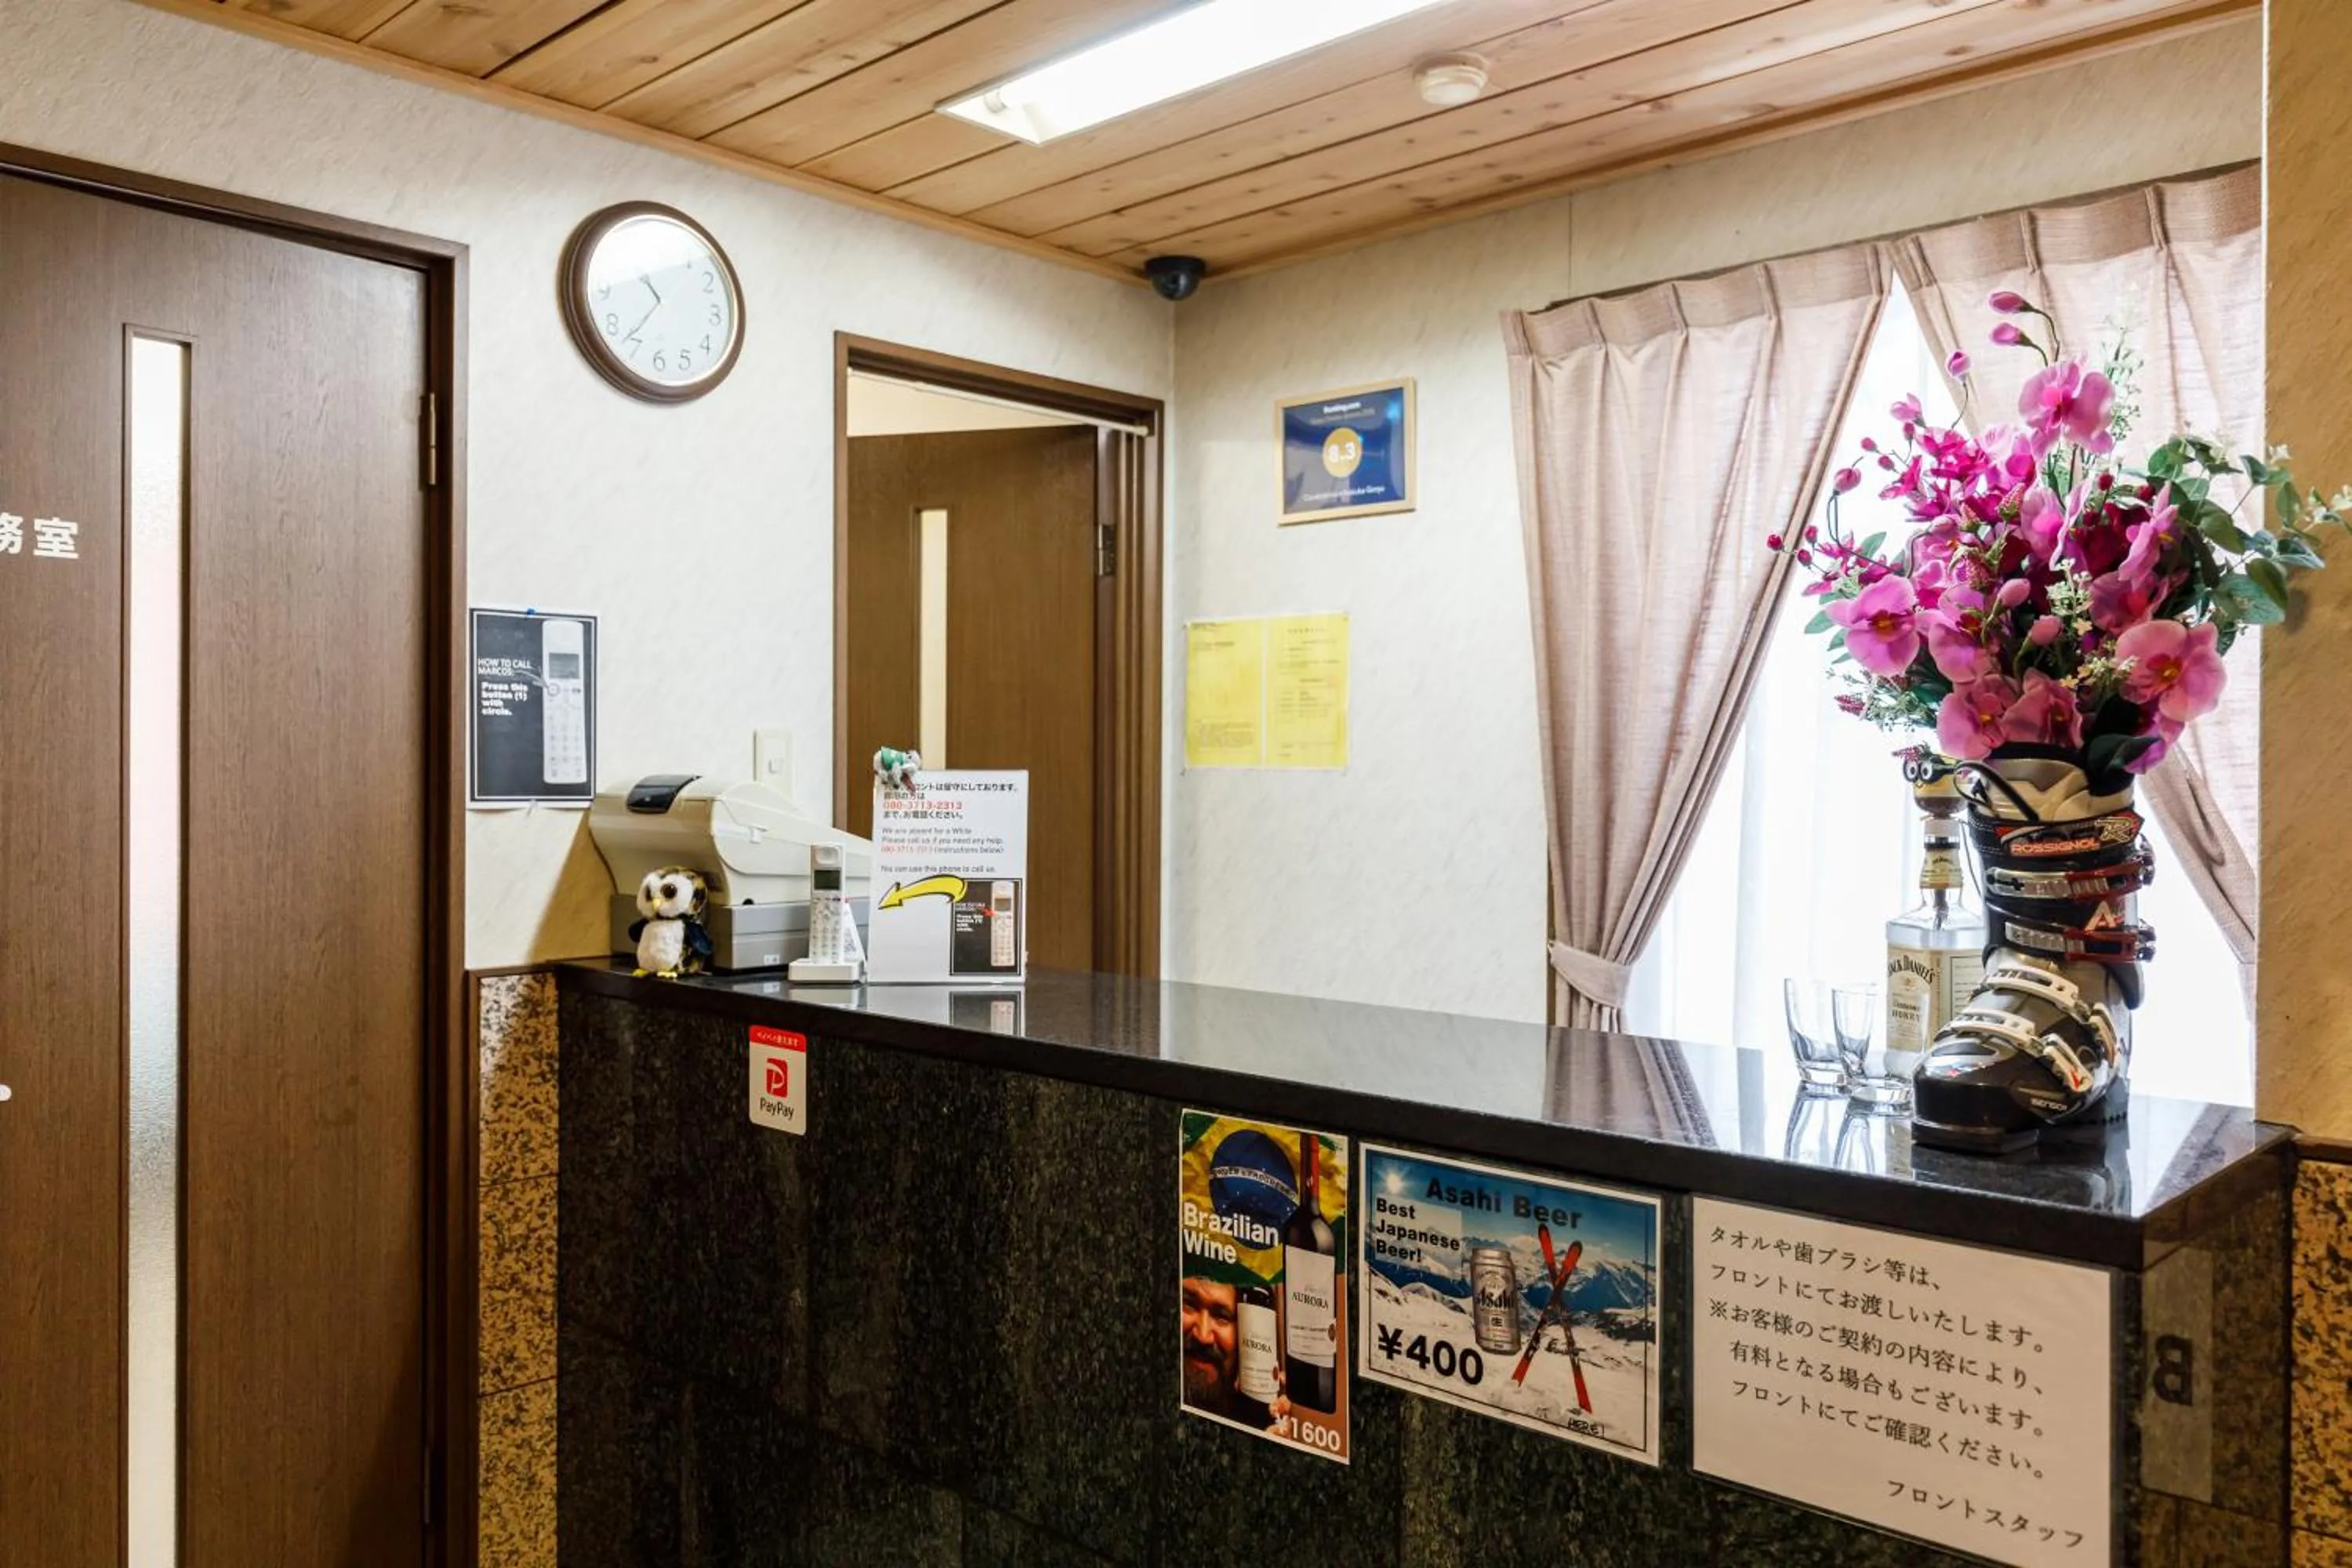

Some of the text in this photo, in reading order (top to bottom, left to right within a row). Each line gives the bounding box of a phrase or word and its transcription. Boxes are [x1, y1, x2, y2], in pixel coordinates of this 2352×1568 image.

[702, 271, 714, 293] 2
[606, 313, 619, 336] 8
[709, 304, 721, 326] 3
[699, 334, 711, 356] 4
[653, 350, 666, 371] 6
[679, 350, 691, 370] 5
[1329, 441, 1356, 463] 8.3
[500, 659, 511, 667] TO
[513, 659, 531, 669] CALL
[2011, 837, 2101, 855] ROSSIGNOL
[760, 1098, 794, 1120] PayPay
[1376, 1197, 1416, 1220] Best
[1426, 1178, 1583, 1229] Asahi Beer
[1183, 1202, 1279, 1247] Brazilian
[1376, 1219, 1460, 1251] Japanese
[1183, 1229, 1237, 1265] Wine
[1376, 1239, 1421, 1263] Beer!
[1710, 1225, 1940, 1291] タオルや歯ブラシ等は、
[1291, 1291, 1329, 1309] AURORA
[1710, 1264, 2044, 1353] フロントにてお渡しいたします。
[1377, 1323, 1484, 1386] ¥400
[1730, 1339, 2044, 1437] 有料となる場合もございます。
[1732, 1380, 2044, 1479] フロントにてご確認ください。
[1887, 1479, 2084, 1548] フロントスタッフ
